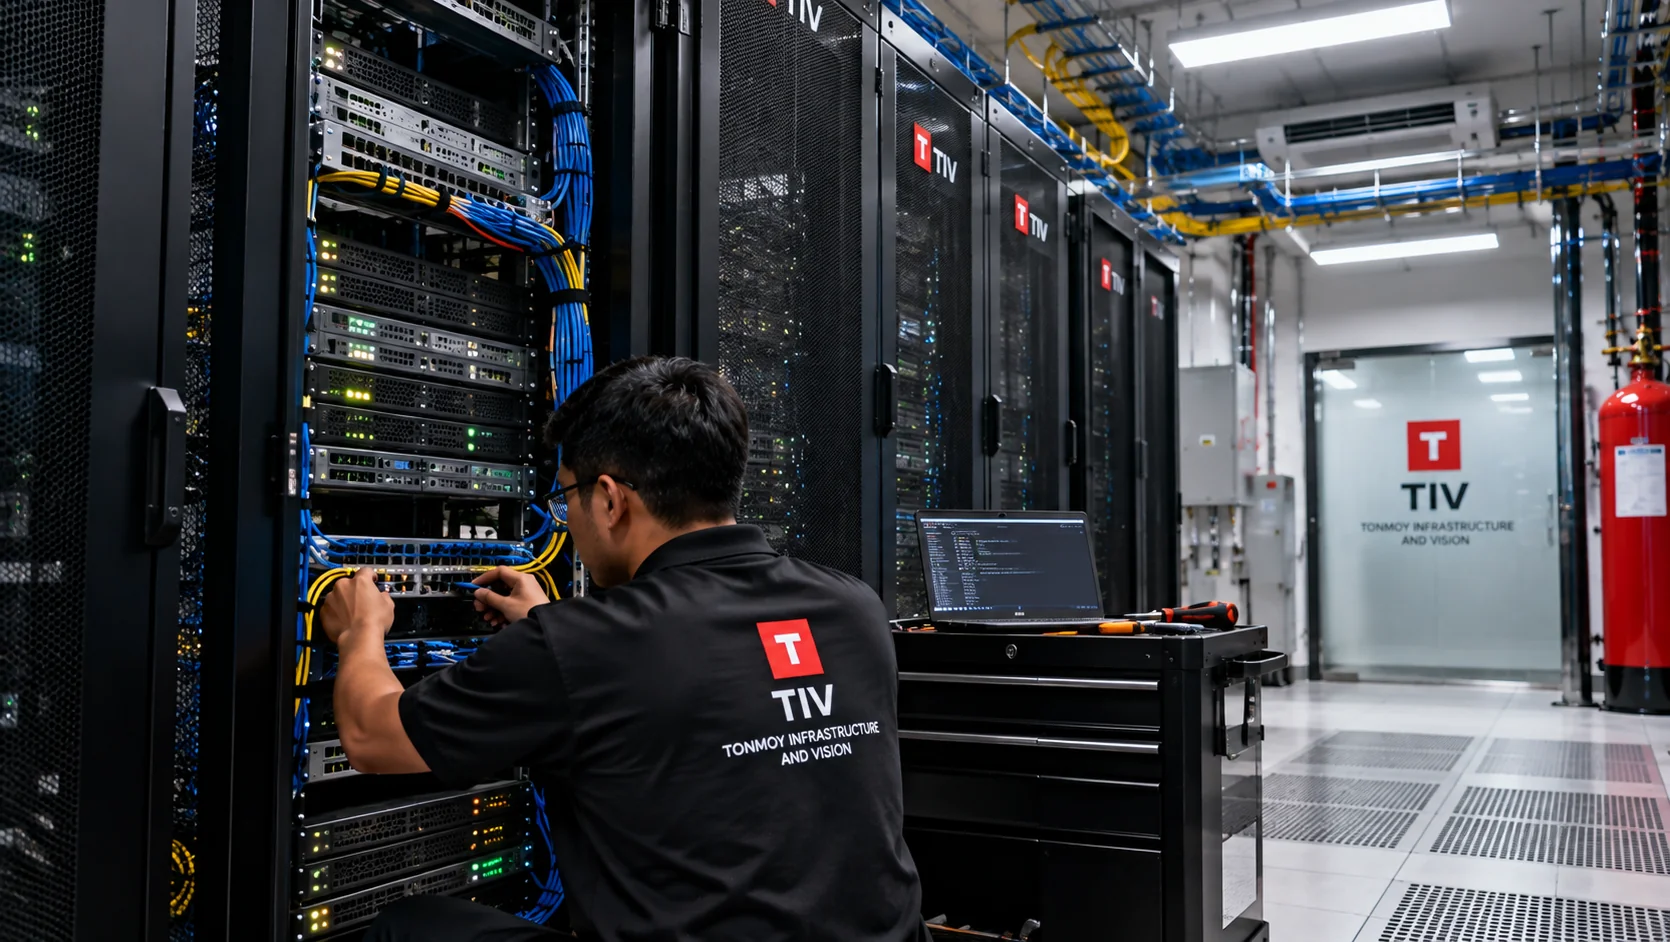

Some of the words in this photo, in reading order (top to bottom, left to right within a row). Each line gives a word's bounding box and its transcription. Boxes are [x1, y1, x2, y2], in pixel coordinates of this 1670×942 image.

[917, 133, 928, 160] T
[932, 146, 958, 183] TIV
[1017, 202, 1026, 226] T
[1029, 212, 1048, 242] TIV
[1419, 431, 1447, 461] T
[1401, 482, 1469, 511] TIV
[1361, 522, 1410, 532] TONMOY
[1413, 520, 1514, 532] INFRASTRUCTURE
[1401, 535, 1427, 545] AND
[1431, 535, 1470, 545] VISION
[774, 632, 801, 665] T
[771, 684, 833, 722] TIV
[722, 735, 785, 757] TONMOY
[788, 721, 880, 746] INFRASTRUCTURE
[781, 749, 809, 766] AND
[811, 742, 852, 760] VISION
